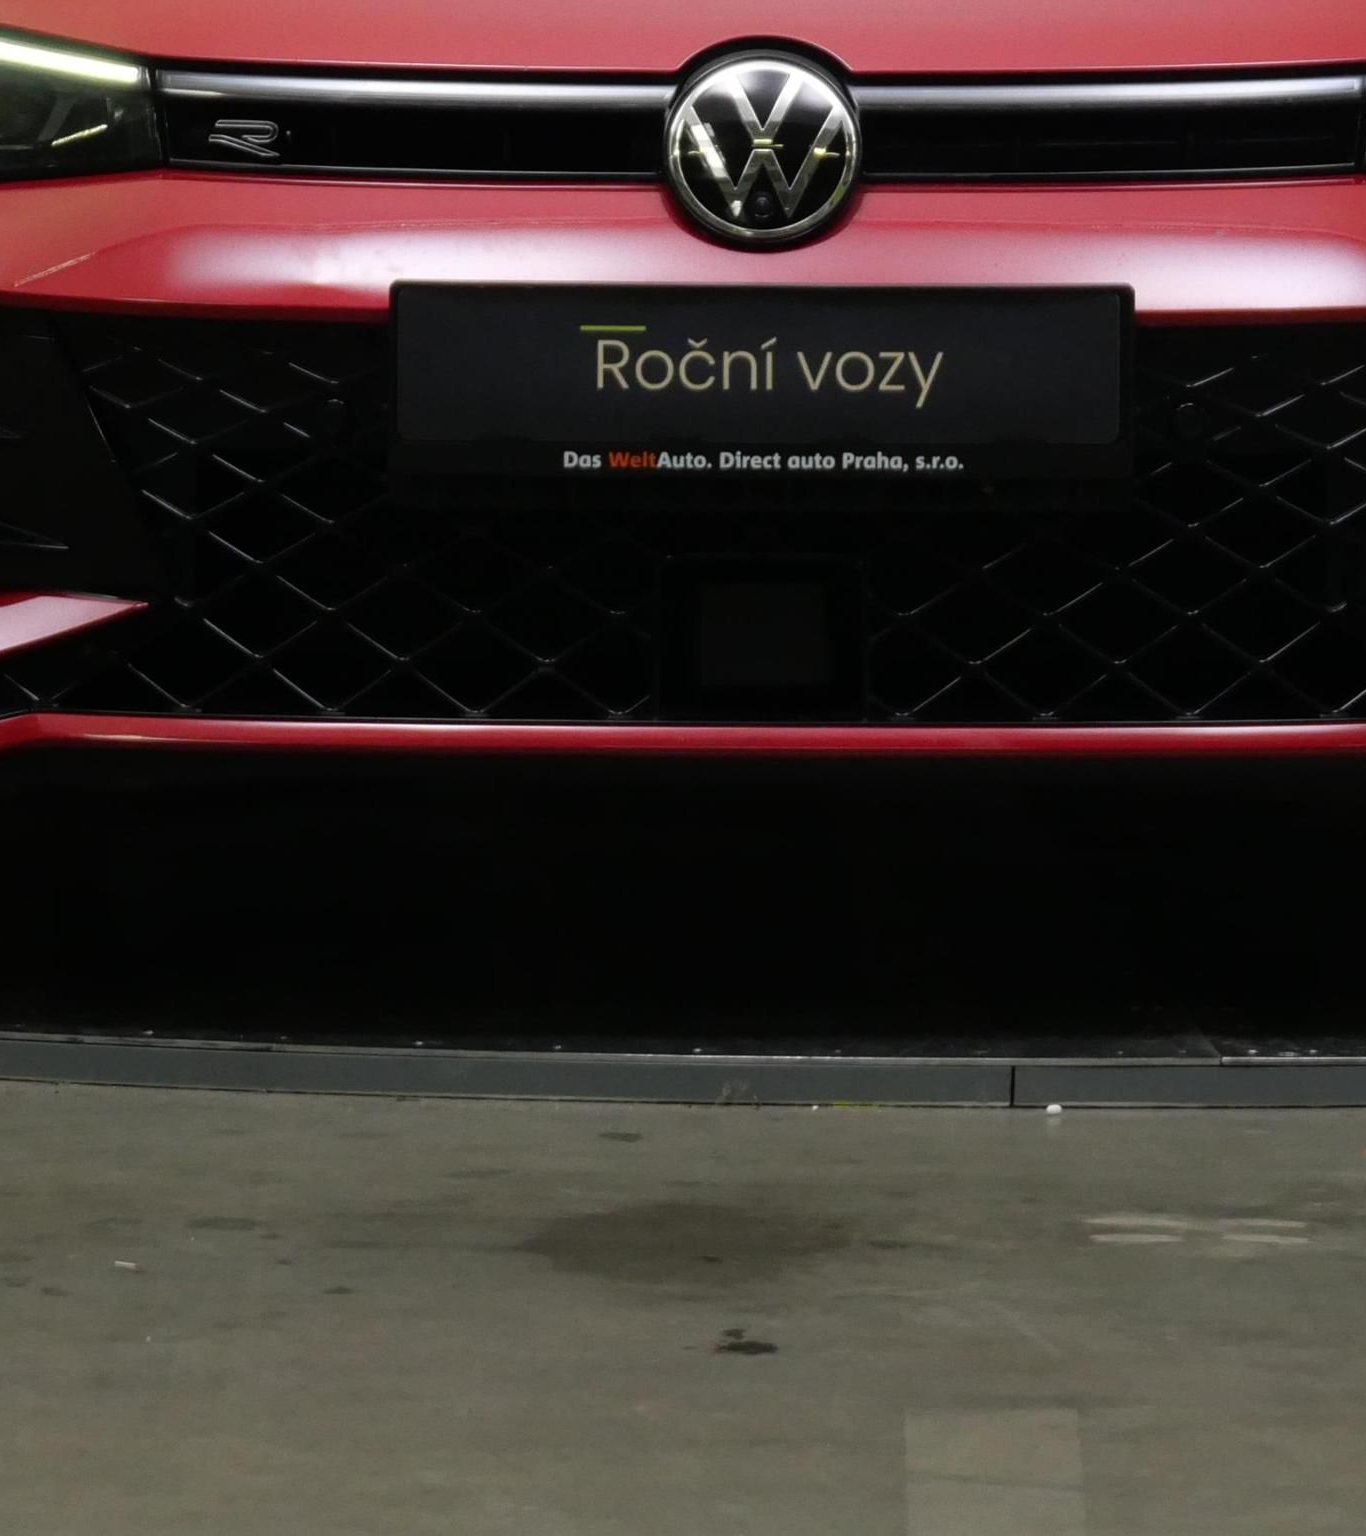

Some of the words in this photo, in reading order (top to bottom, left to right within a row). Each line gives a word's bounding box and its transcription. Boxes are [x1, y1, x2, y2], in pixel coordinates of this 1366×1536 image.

[675, 61, 851, 226] VW
[595, 336, 777, 391] Roční
[795, 350, 944, 409] vozy
[562, 449, 602, 469] Das
[608, 450, 712, 469] WeltAuto.
[718, 450, 781, 469] Direct
[786, 451, 836, 470] auto
[841, 450, 909, 473] Praha,
[914, 454, 964, 470] s.r.o.
